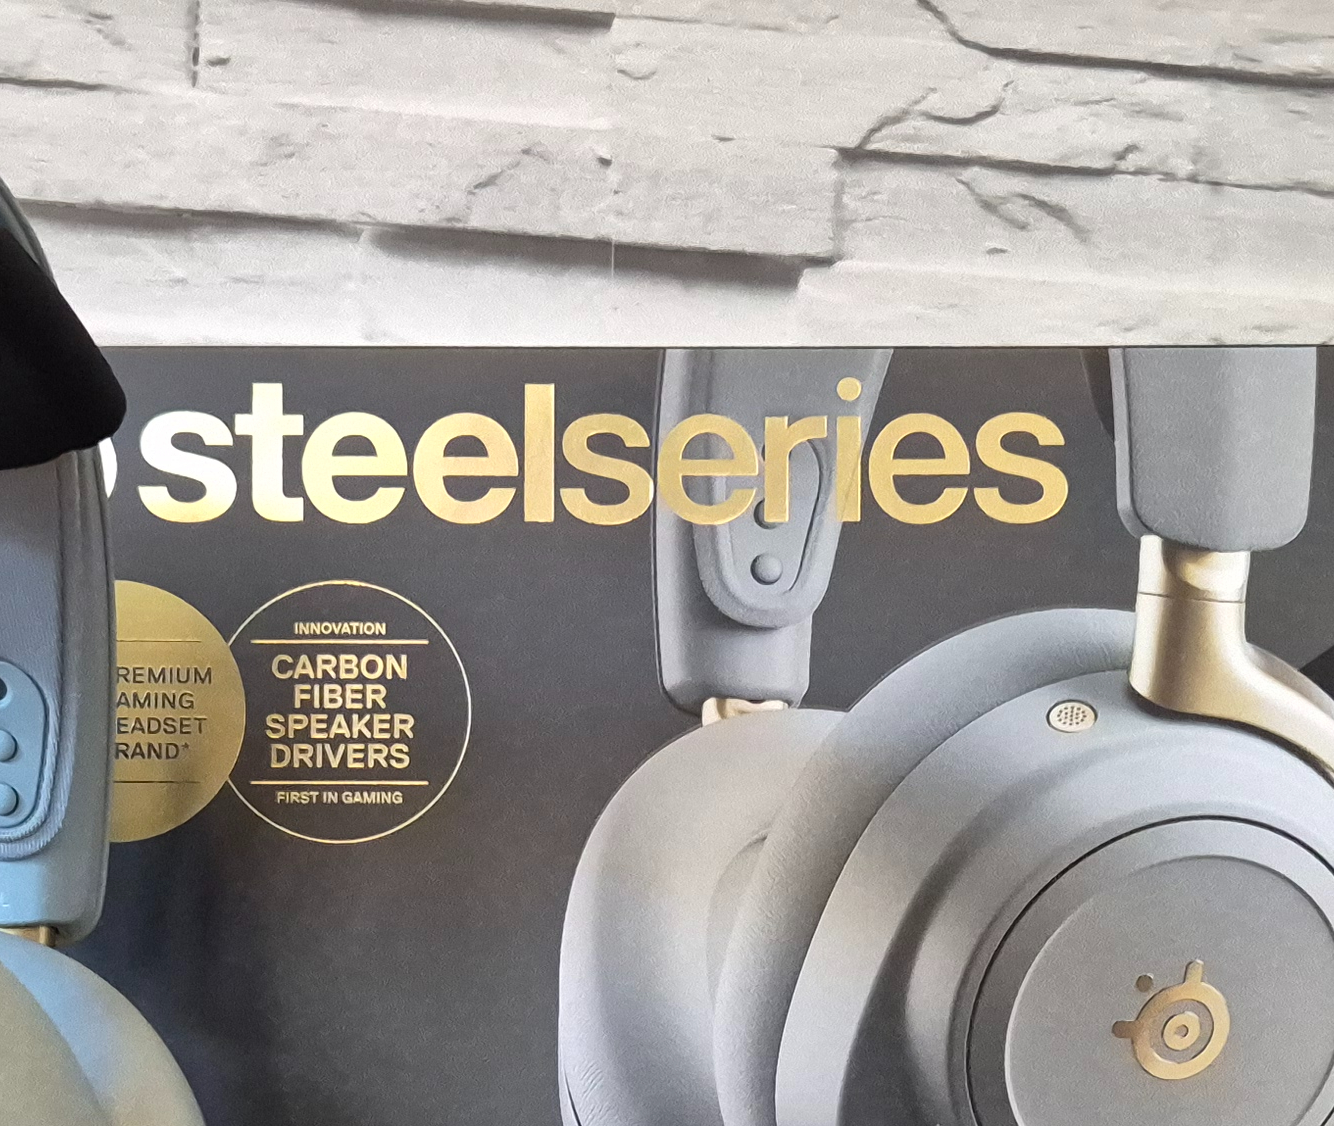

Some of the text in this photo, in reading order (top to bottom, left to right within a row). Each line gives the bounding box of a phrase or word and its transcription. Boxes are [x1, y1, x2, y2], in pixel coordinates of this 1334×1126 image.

[137, 377, 1068, 525] steelseries
[294, 621, 387, 636] INNOVATION
[116, 665, 213, 685] REMIUM
[271, 653, 409, 681] CARBON
[116, 691, 195, 710] AMING
[294, 683, 387, 710] FIBER
[116, 716, 208, 735] EADSET
[265, 713, 415, 740] SPEAKER
[114, 742, 190, 760] RAND
[270, 743, 411, 769] DRIVERS
[277, 791, 404, 806] FIRST IN GAMING
